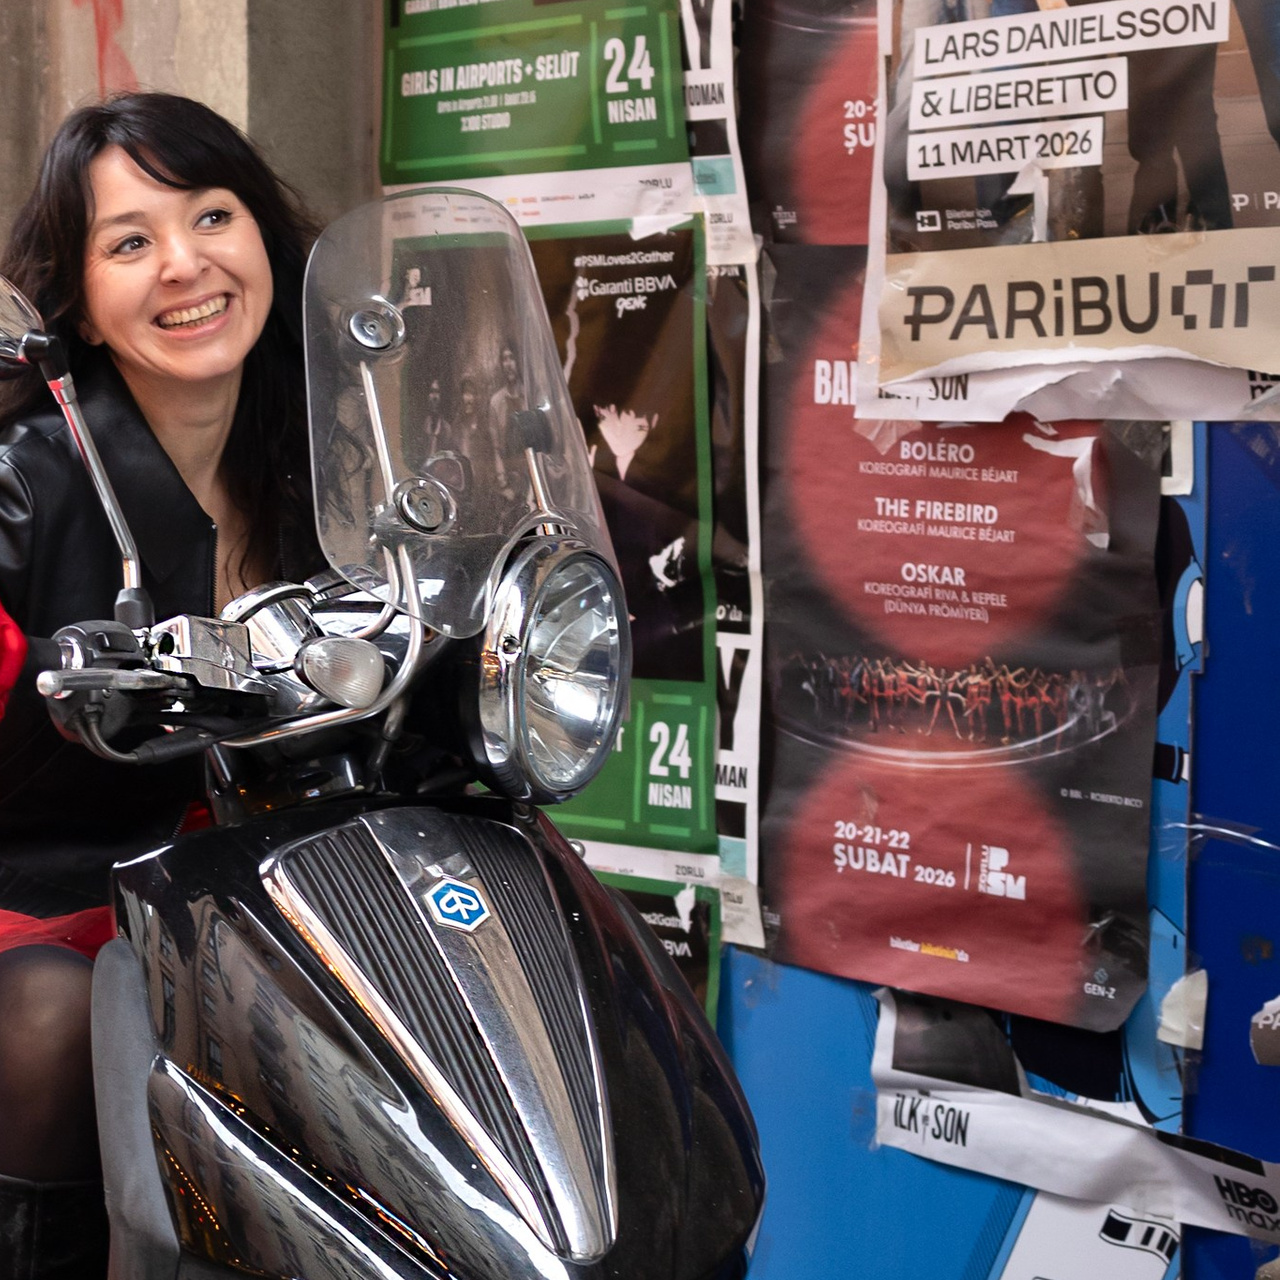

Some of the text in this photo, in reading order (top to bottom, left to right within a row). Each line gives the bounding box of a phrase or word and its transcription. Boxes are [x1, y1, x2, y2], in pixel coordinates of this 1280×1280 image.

[924, 1, 1217, 65] LARS DANIELSSON
[401, 68, 438, 97] GIRLS
[440, 67, 454, 93] IN
[456, 58, 523, 90] AIRPORTS
[604, 35, 655, 94] 24
[920, 69, 1118, 118] & LIBERETTO
[917, 129, 1093, 168] 11 MART 2026
[573, 250, 675, 269] #PSMLoves2Gather
[588, 275, 677, 298] Garanti BBVA
[899, 437, 975, 464] BOLÉRO
[858, 460, 1019, 485] KOREOGRAFİ MAURICE BÉJART
[875, 496, 999, 525] THE FIREBIRD
[857, 517, 1016, 544] KOREOGRAFİ MAURICE BÉJART
[900, 562, 966, 587] OSKAR
[864, 580, 1008, 608] KOREOGRAFİ RIVA & REPELE
[884, 597, 927, 618] (DÜNYA
[648, 721, 693, 779] 24
[648, 782, 693, 810] NİSAN
[834, 820, 910, 850] 20-21-22
[675, 865, 705, 878] ZORLU
[833, 842, 956, 890] ŞUBAT 2026
[1084, 981, 1116, 1001] GEN-Z
[931, 1104, 970, 1147] SON
[1214, 1175, 1278, 1214] HBO
